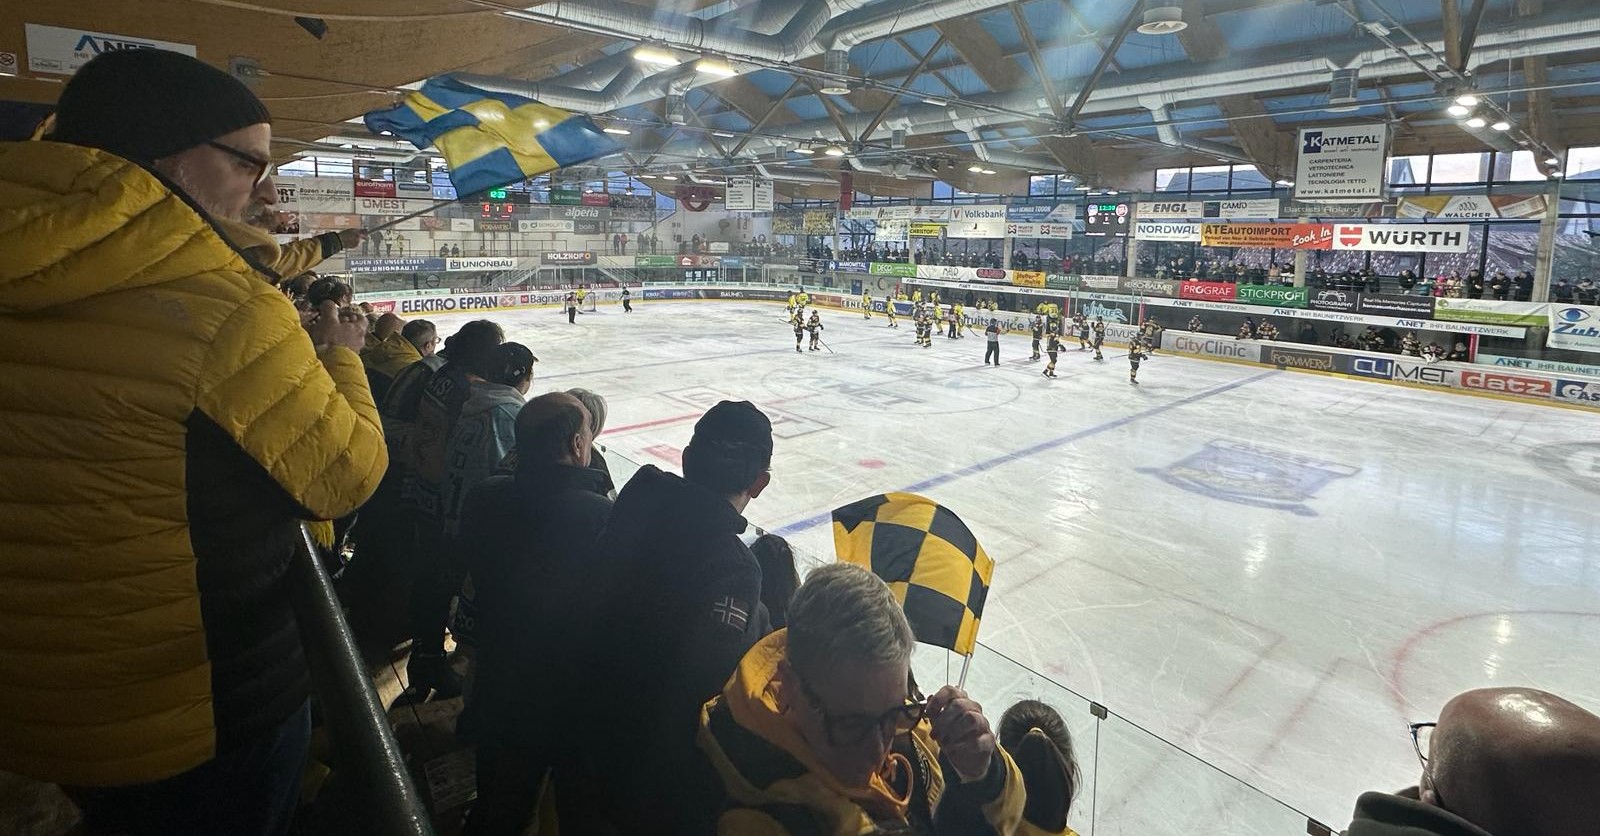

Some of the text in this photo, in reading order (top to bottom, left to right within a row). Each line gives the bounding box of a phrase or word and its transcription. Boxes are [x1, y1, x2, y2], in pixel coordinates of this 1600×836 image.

[1311, 135, 1379, 148] KATMETAL
[565, 207, 599, 219] alperia
[964, 209, 1005, 218] Volksbank
[1152, 203, 1188, 213] ENGL
[1137, 225, 1200, 235] NORDWAL
[1292, 230, 1316, 246] Look
[1369, 230, 1460, 246] WÜRTH
[462, 260, 513, 268] UNIONBAU
[1184, 285, 1232, 296] PROGRAF
[1240, 288, 1305, 301] STICKPROFI
[402, 296, 498, 313] ELEKTRO EPPAN
[530, 294, 566, 304] Bagnara
[1311, 299, 1354, 308] PHOTOGRAPHY
[1273, 308, 1298, 316] ANET
[963, 314, 1024, 331] fruitsrvice
[1396, 319, 1426, 328] ANET
[1446, 324, 1510, 335] BAUNETZWERK
[1106, 328, 1136, 339] DIVUS
[1175, 336, 1247, 358] CityClinic
[1273, 352, 1328, 370] FORMWERK
[1495, 357, 1533, 368] ANET
[1557, 364, 1600, 375] BAUNET
[1466, 373, 1545, 398] datz
